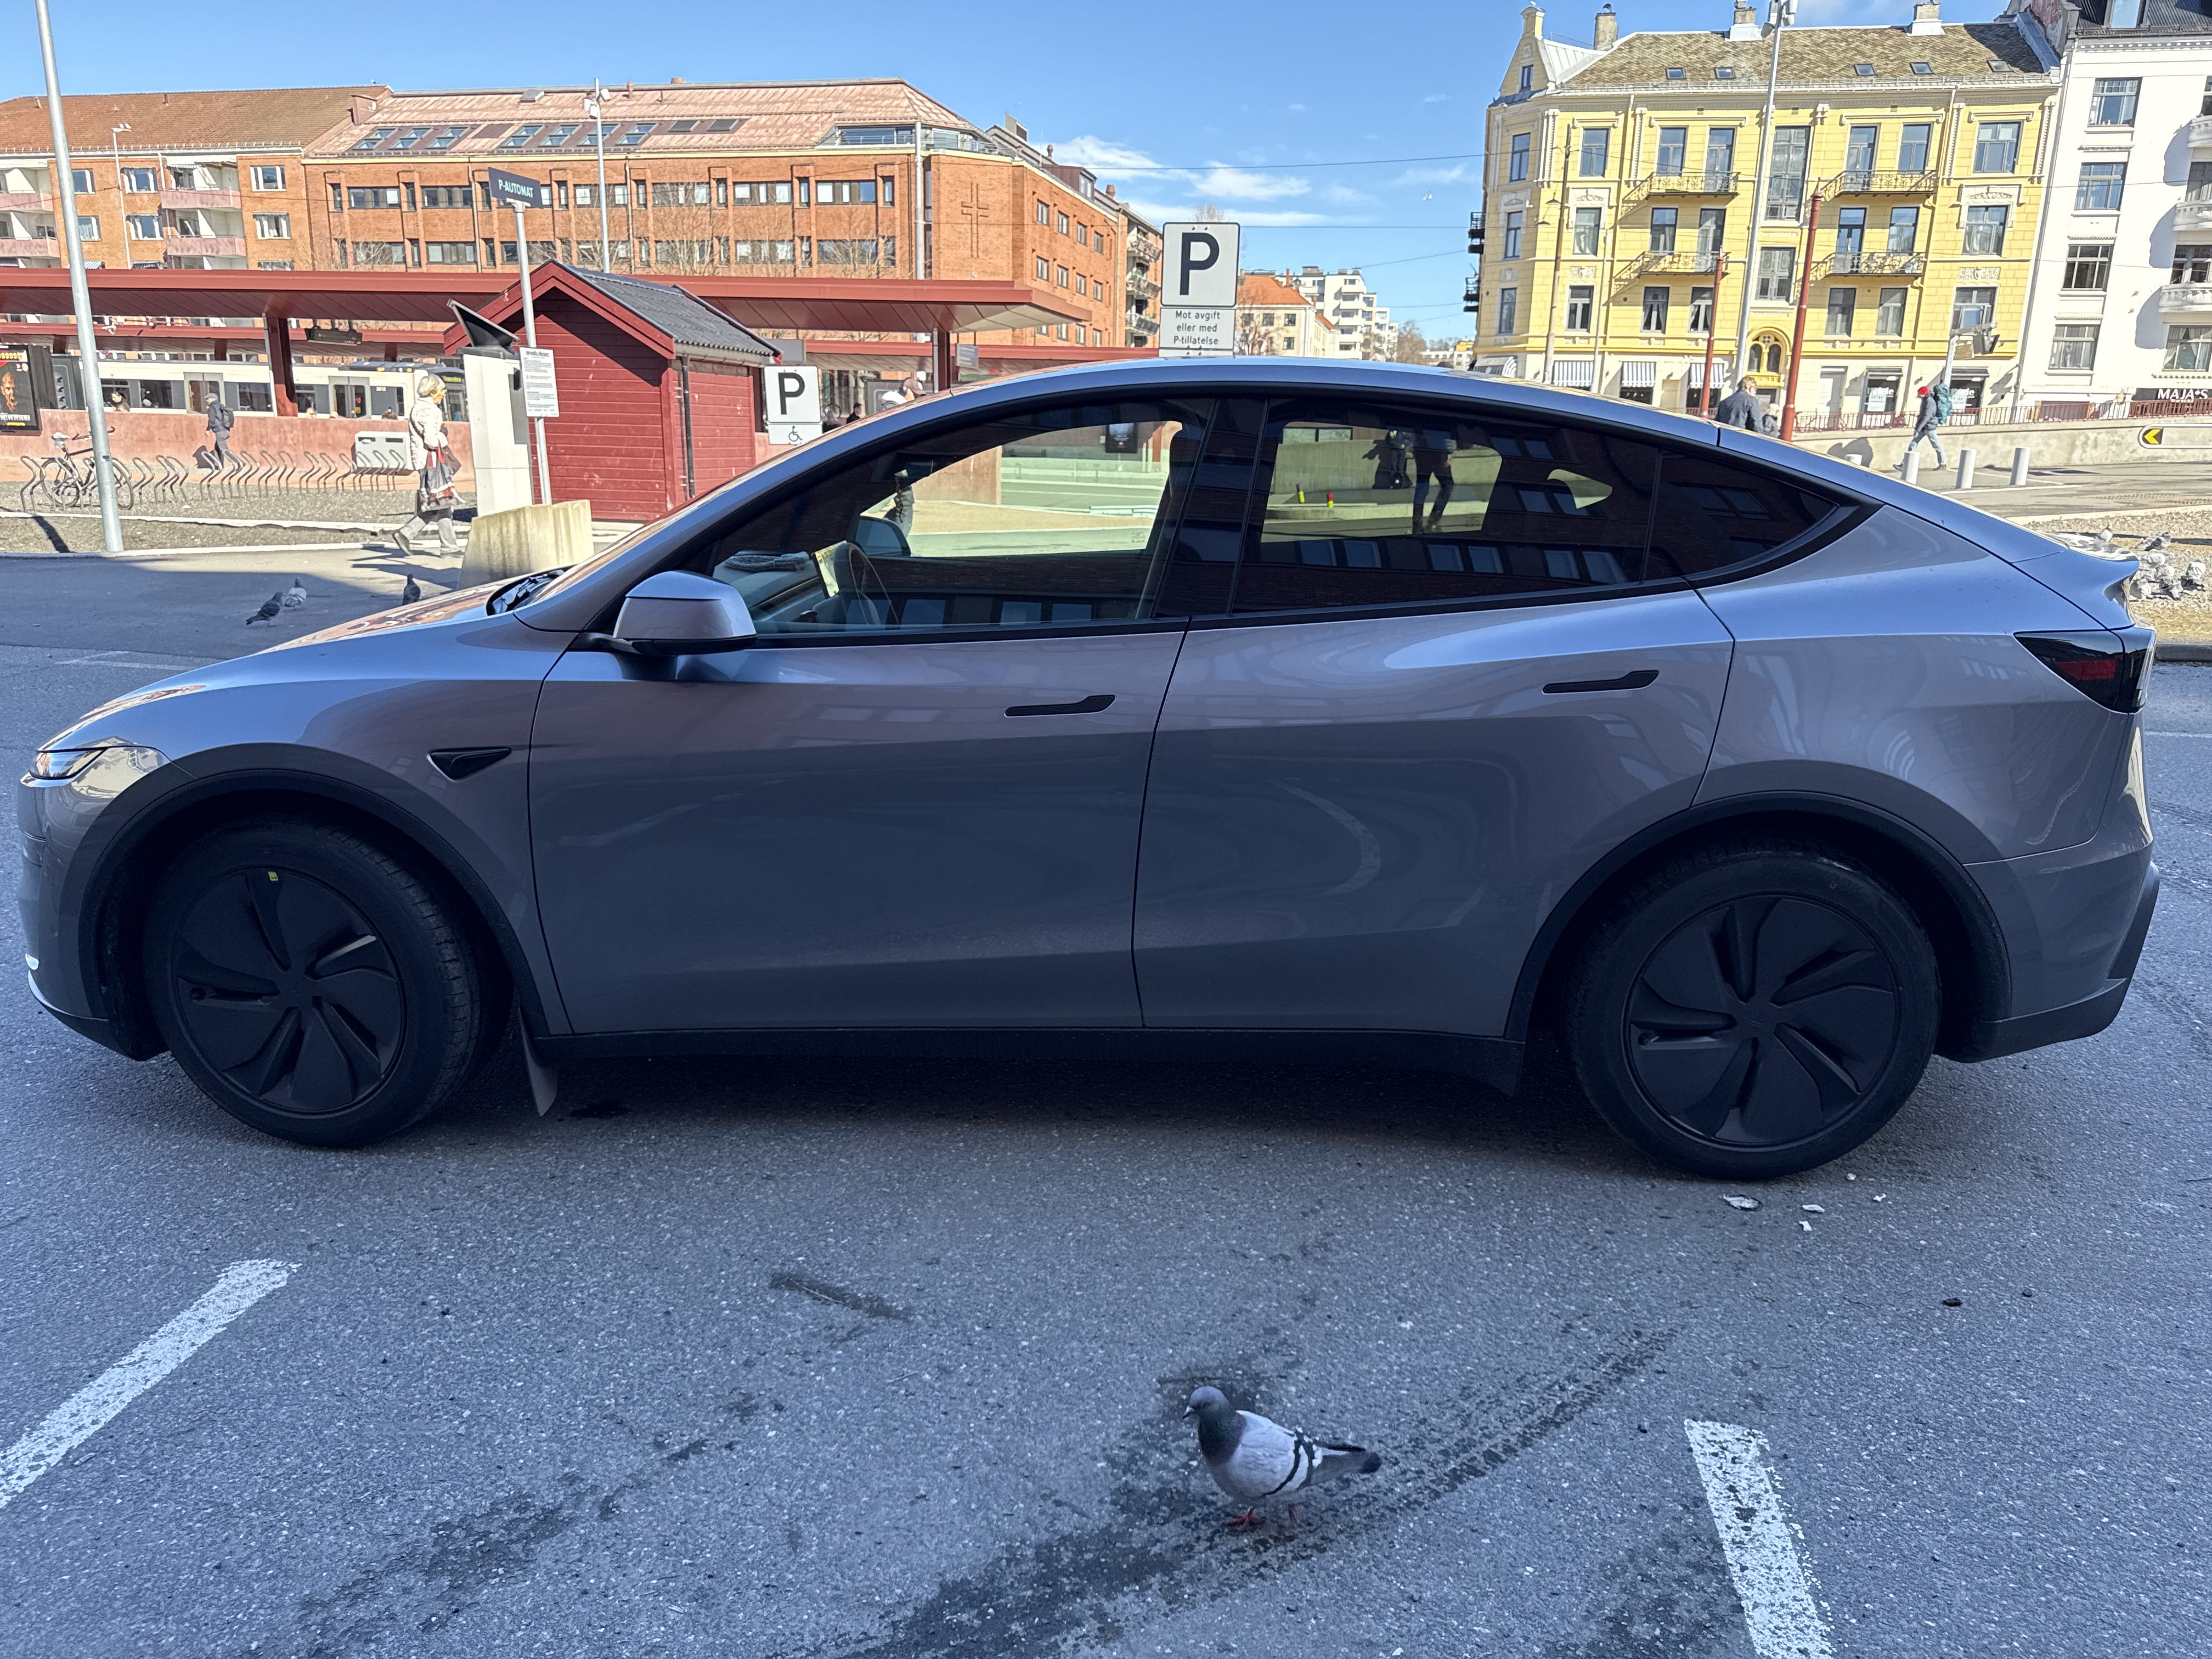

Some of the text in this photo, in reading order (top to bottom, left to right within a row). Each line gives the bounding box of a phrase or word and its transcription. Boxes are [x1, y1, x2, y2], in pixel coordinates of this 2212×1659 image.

[498, 179, 533, 198] P-AUTOMAT
[1180, 233, 1220, 295] P
[1175, 311, 1220, 321] Mot avgift
[1177, 323, 1217, 332] eller med
[1173, 336, 1218, 345] P-tillatelse
[778, 373, 805, 415] P
